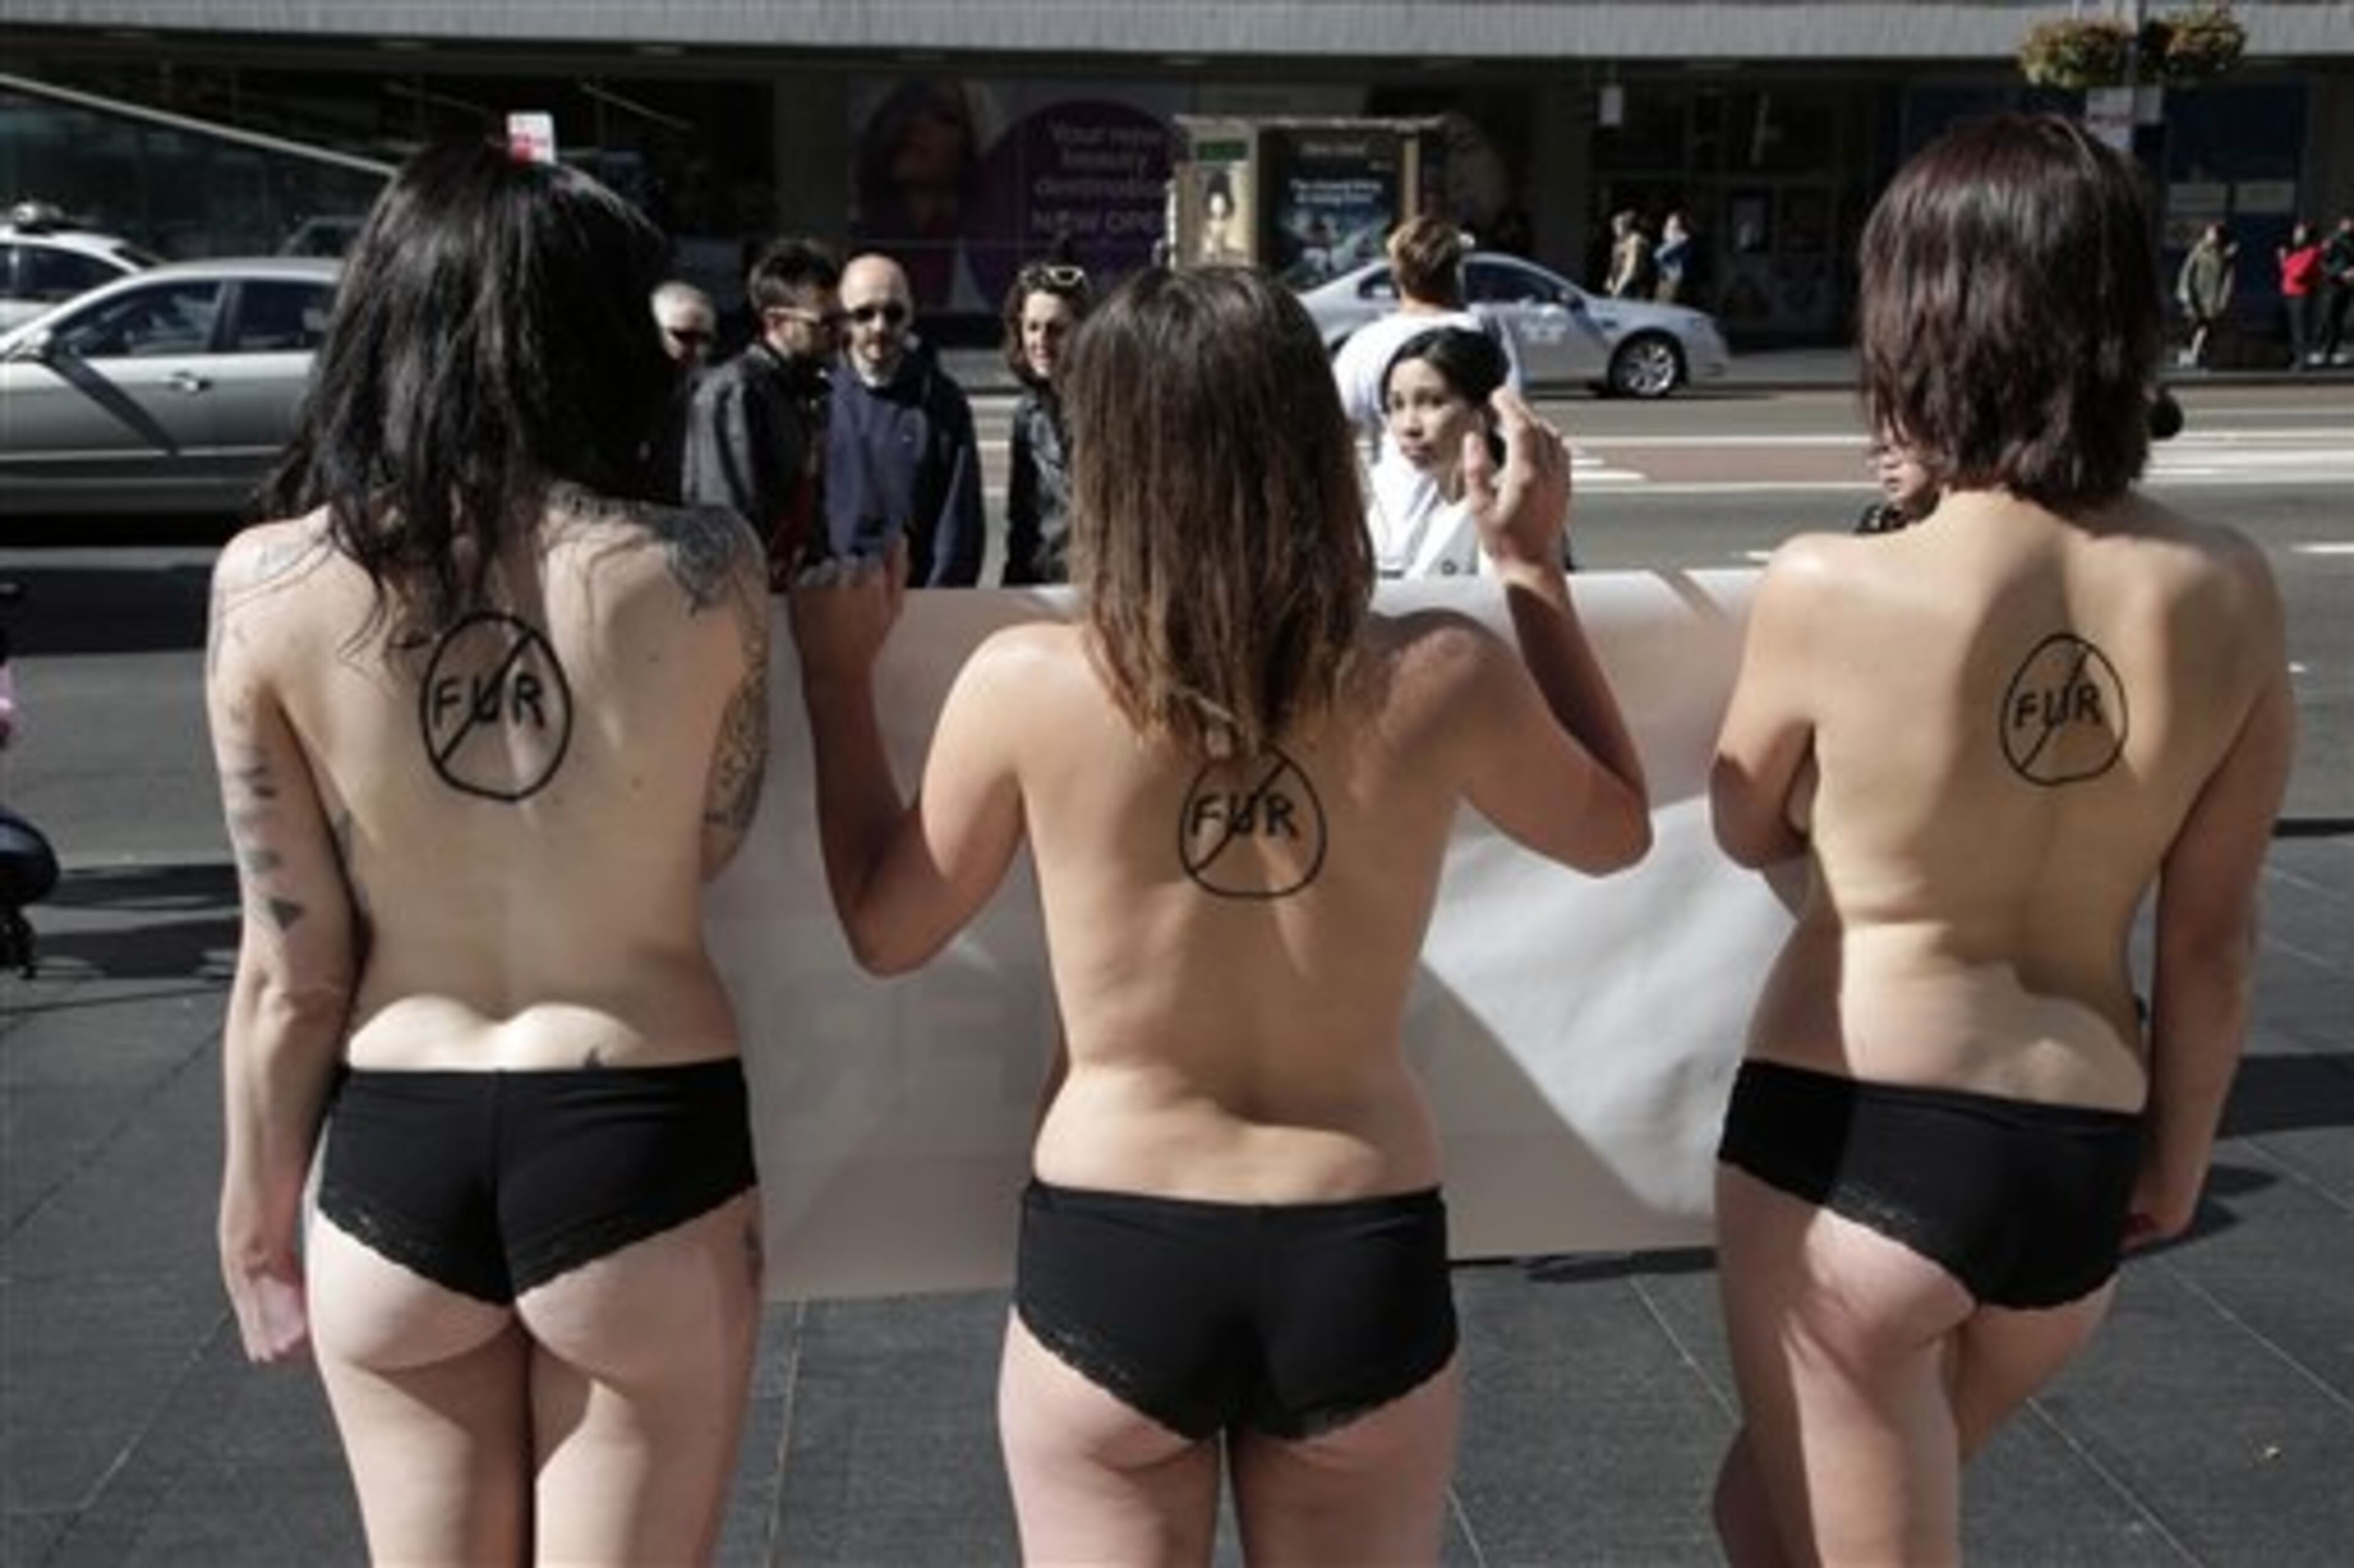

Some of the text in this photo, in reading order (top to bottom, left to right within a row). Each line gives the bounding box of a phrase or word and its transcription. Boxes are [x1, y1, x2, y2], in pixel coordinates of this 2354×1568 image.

[432, 674, 545, 729] FUR
[2014, 683, 2103, 729] FUR
[1192, 793, 1300, 840] FUR
